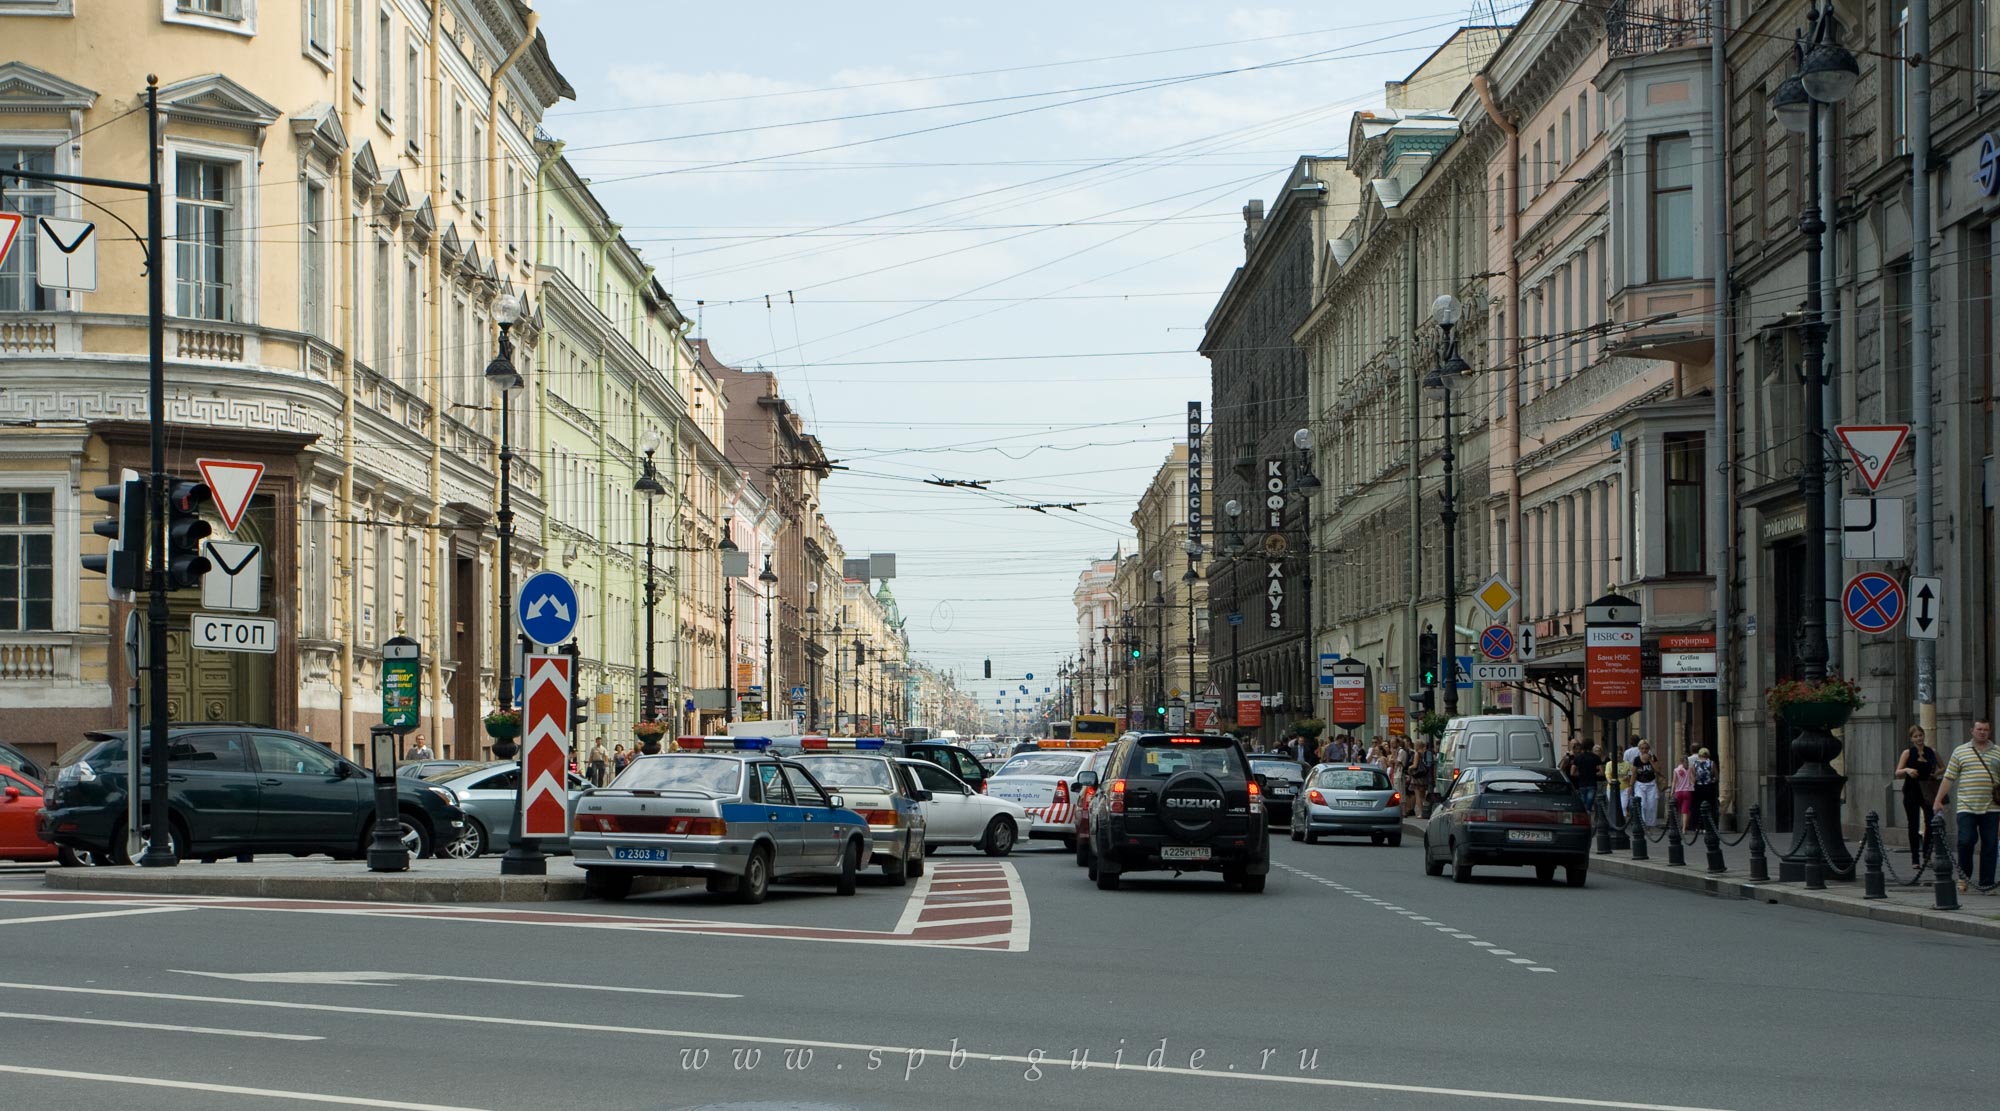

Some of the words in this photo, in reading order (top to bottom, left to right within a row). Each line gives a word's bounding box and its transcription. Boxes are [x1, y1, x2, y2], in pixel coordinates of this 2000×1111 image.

[1267, 460, 1284, 527] КОФЕ
[1267, 562, 1283, 628] ХАУЗ
[204, 622, 265, 645] СТОП
[1592, 631, 1620, 641] HSBC
[1670, 636, 1710, 647] турфирма
[1597, 653, 1614, 661] Банк
[1614, 653, 1631, 661] HSBC
[1478, 666, 1517, 678] СТОП
[1166, 798, 1221, 809] SUZUKI
[627, 848, 651, 859] 2303
[655, 849, 665, 858] 78
